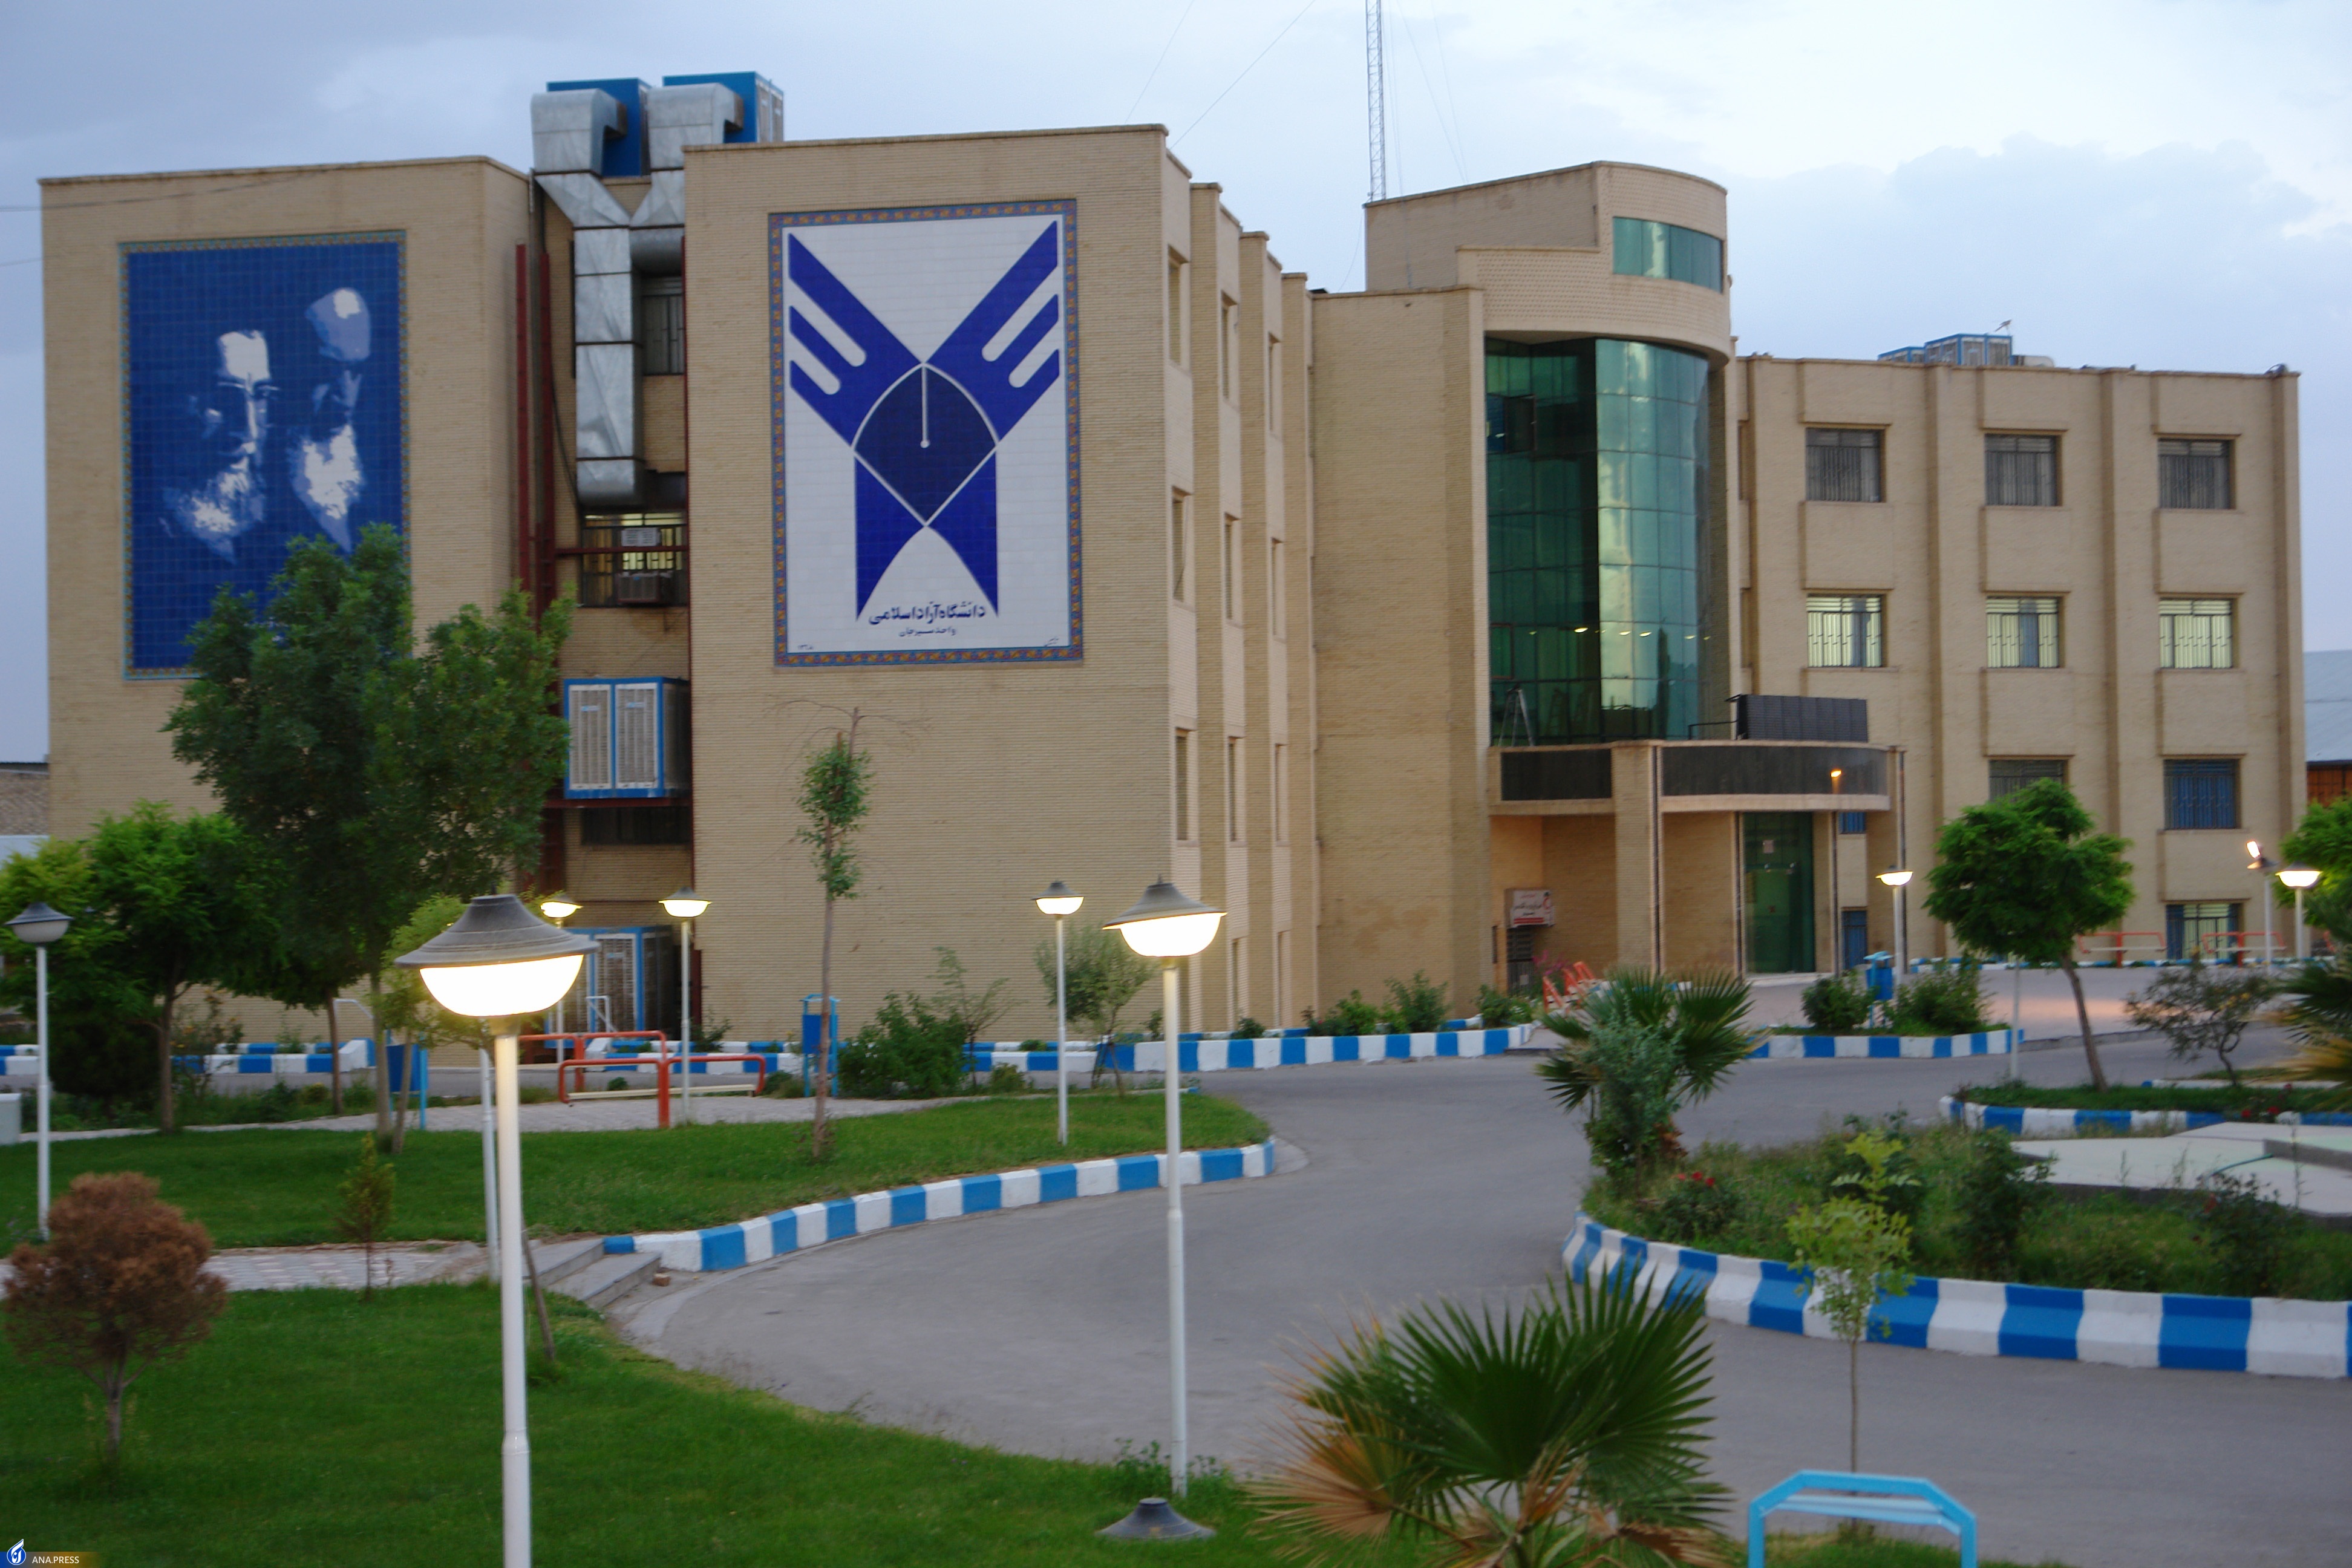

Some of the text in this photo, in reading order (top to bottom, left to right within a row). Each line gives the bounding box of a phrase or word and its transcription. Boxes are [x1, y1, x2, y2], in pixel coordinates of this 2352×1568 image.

[869, 601, 985, 625] دانشگاه آزاد اسلامی
